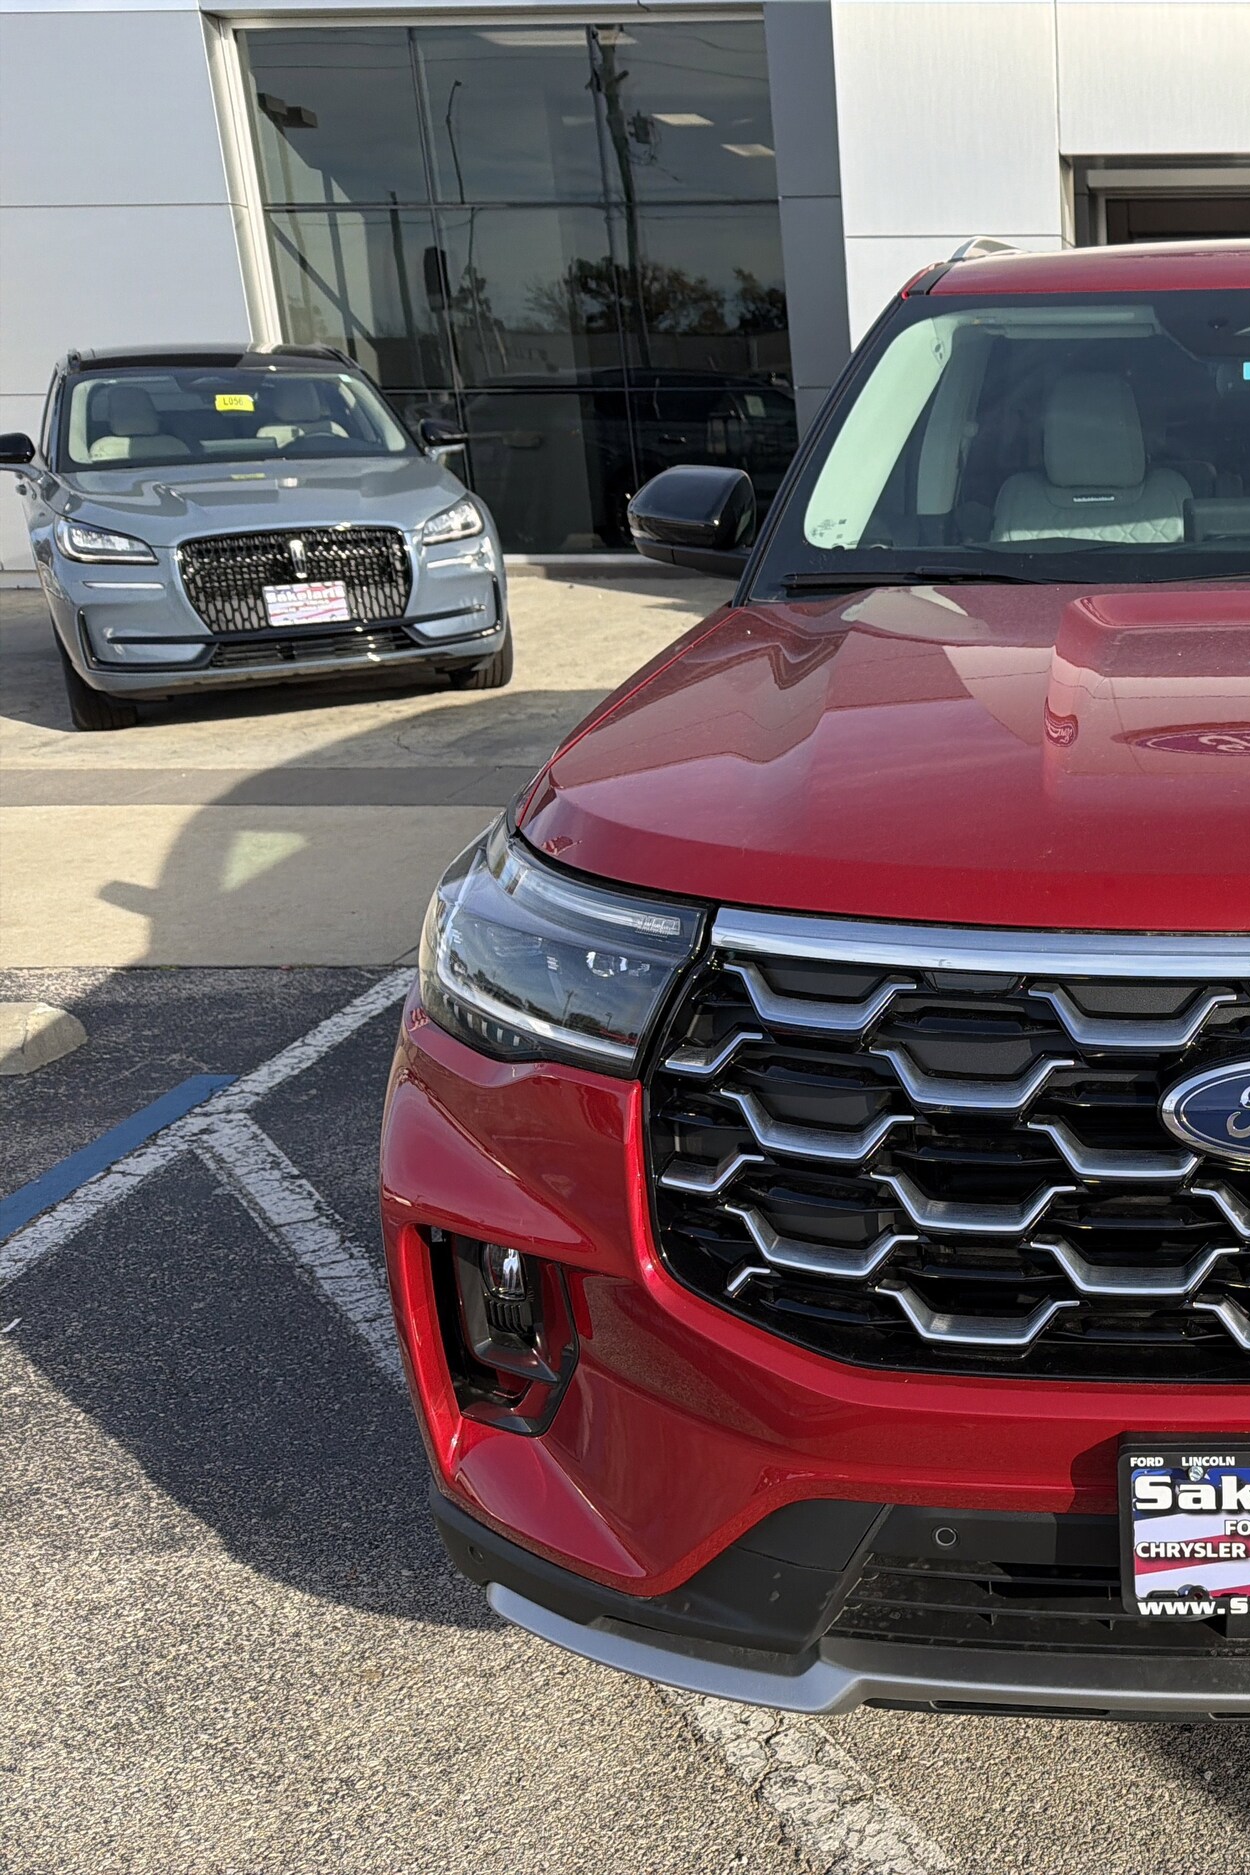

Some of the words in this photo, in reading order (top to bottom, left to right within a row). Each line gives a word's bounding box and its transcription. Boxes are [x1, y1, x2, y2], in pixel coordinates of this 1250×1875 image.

[1130, 1456, 1164, 1467] FORD
[1181, 1456, 1236, 1467] LINCOLN
[1135, 1542, 1246, 1559] CHRYSLER
